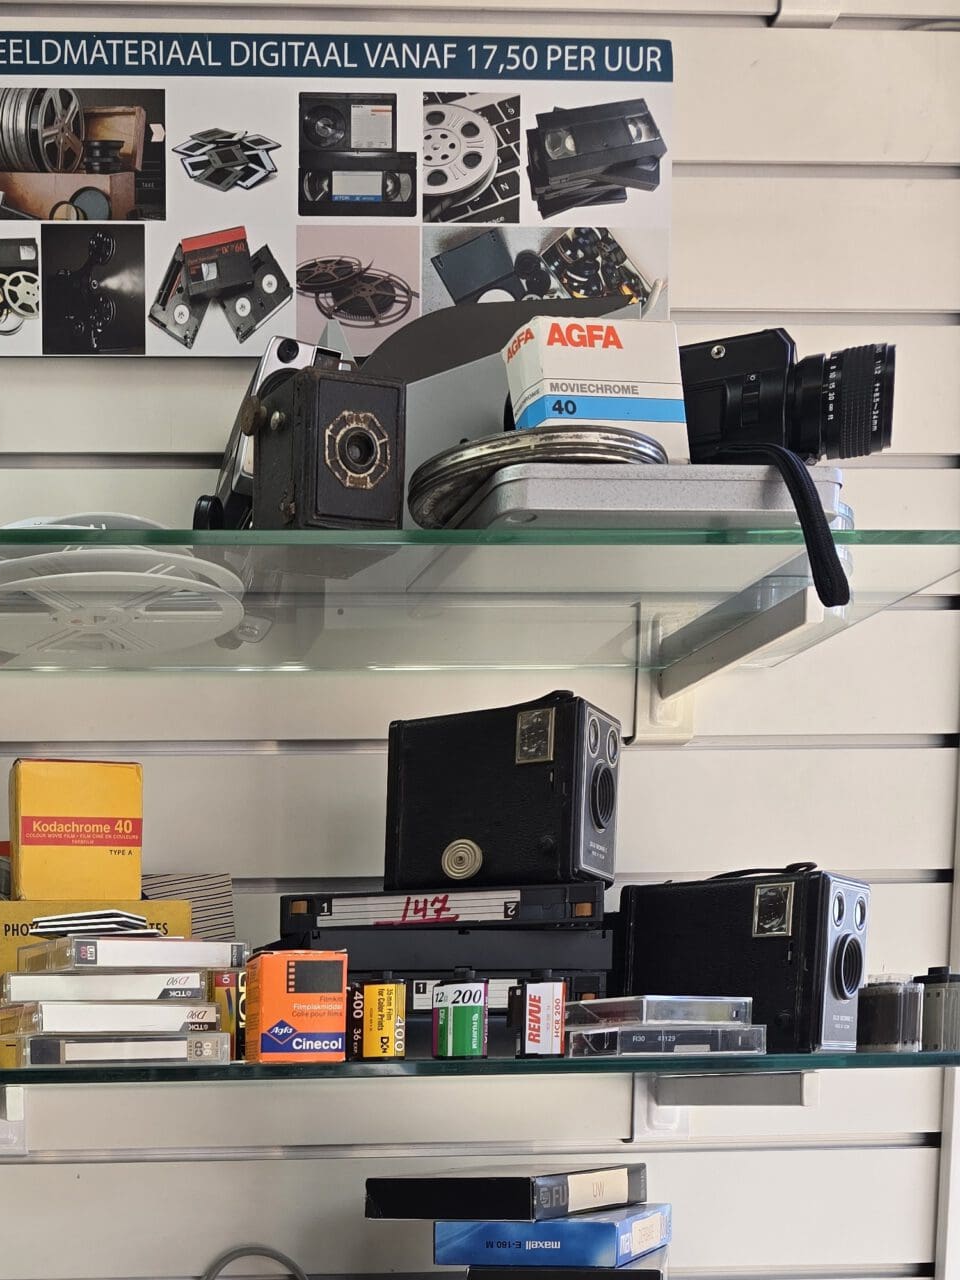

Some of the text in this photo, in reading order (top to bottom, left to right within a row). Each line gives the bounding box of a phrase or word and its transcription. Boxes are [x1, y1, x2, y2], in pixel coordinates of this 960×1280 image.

[230, 40, 358, 68] DIGITAAL
[364, 42, 457, 69] VANAF
[466, 44, 538, 75] 17,50
[545, 46, 596, 72] PER
[603, 46, 663, 73] UUR
[546, 322, 623, 349] AGFA
[506, 327, 535, 364] AGFA
[549, 382, 640, 395] MOVIECHROME
[552, 399, 577, 415] 40
[32, 819, 133, 834] Kodachrome 40
[402, 894, 451, 922] 147
[352, 991, 364, 1019] 400
[435, 989, 483, 1005] 12 200
[377, 998, 386, 1013] Color
[377, 1014, 386, 1031] Prints
[527, 993, 542, 1044] REVUE
[270, 1026, 293, 1036] Agfa
[353, 1028, 362, 1041] 36
[394, 1014, 406, 1052] 400
[292, 1037, 343, 1050] Cinecol
[592, 1181, 605, 1199] UW
[525, 1240, 561, 1250] maxell
